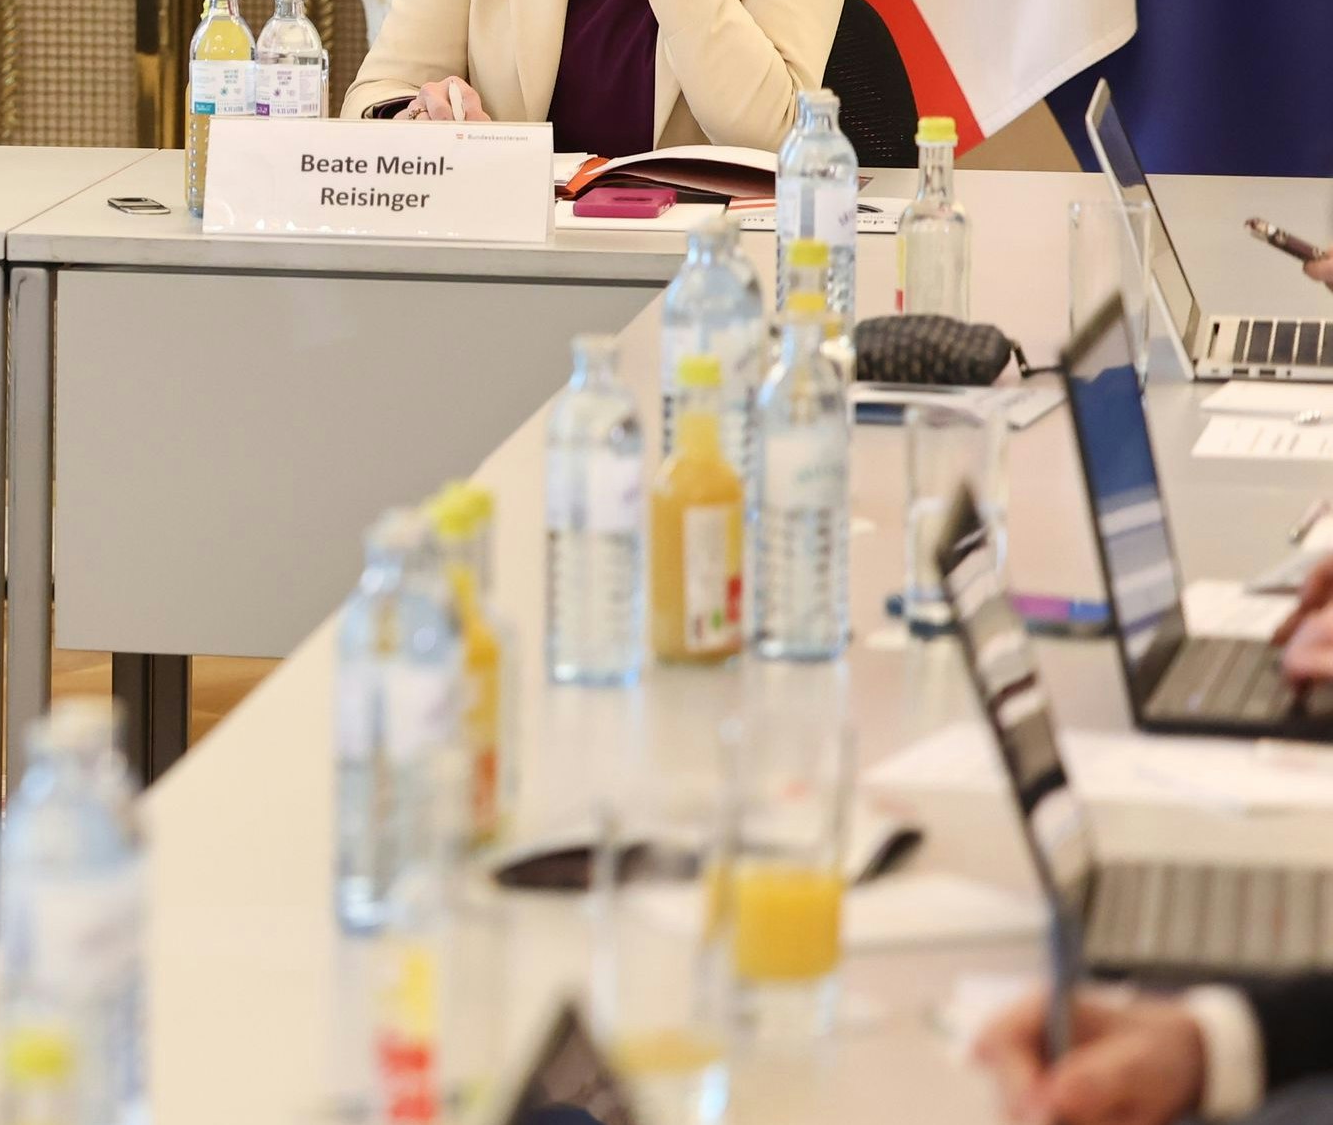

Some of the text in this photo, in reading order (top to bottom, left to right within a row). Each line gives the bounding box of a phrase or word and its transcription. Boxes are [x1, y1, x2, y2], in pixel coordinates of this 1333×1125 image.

[300, 153, 454, 176] Beate Meinl-
[320, 186, 430, 212] Reisinger
